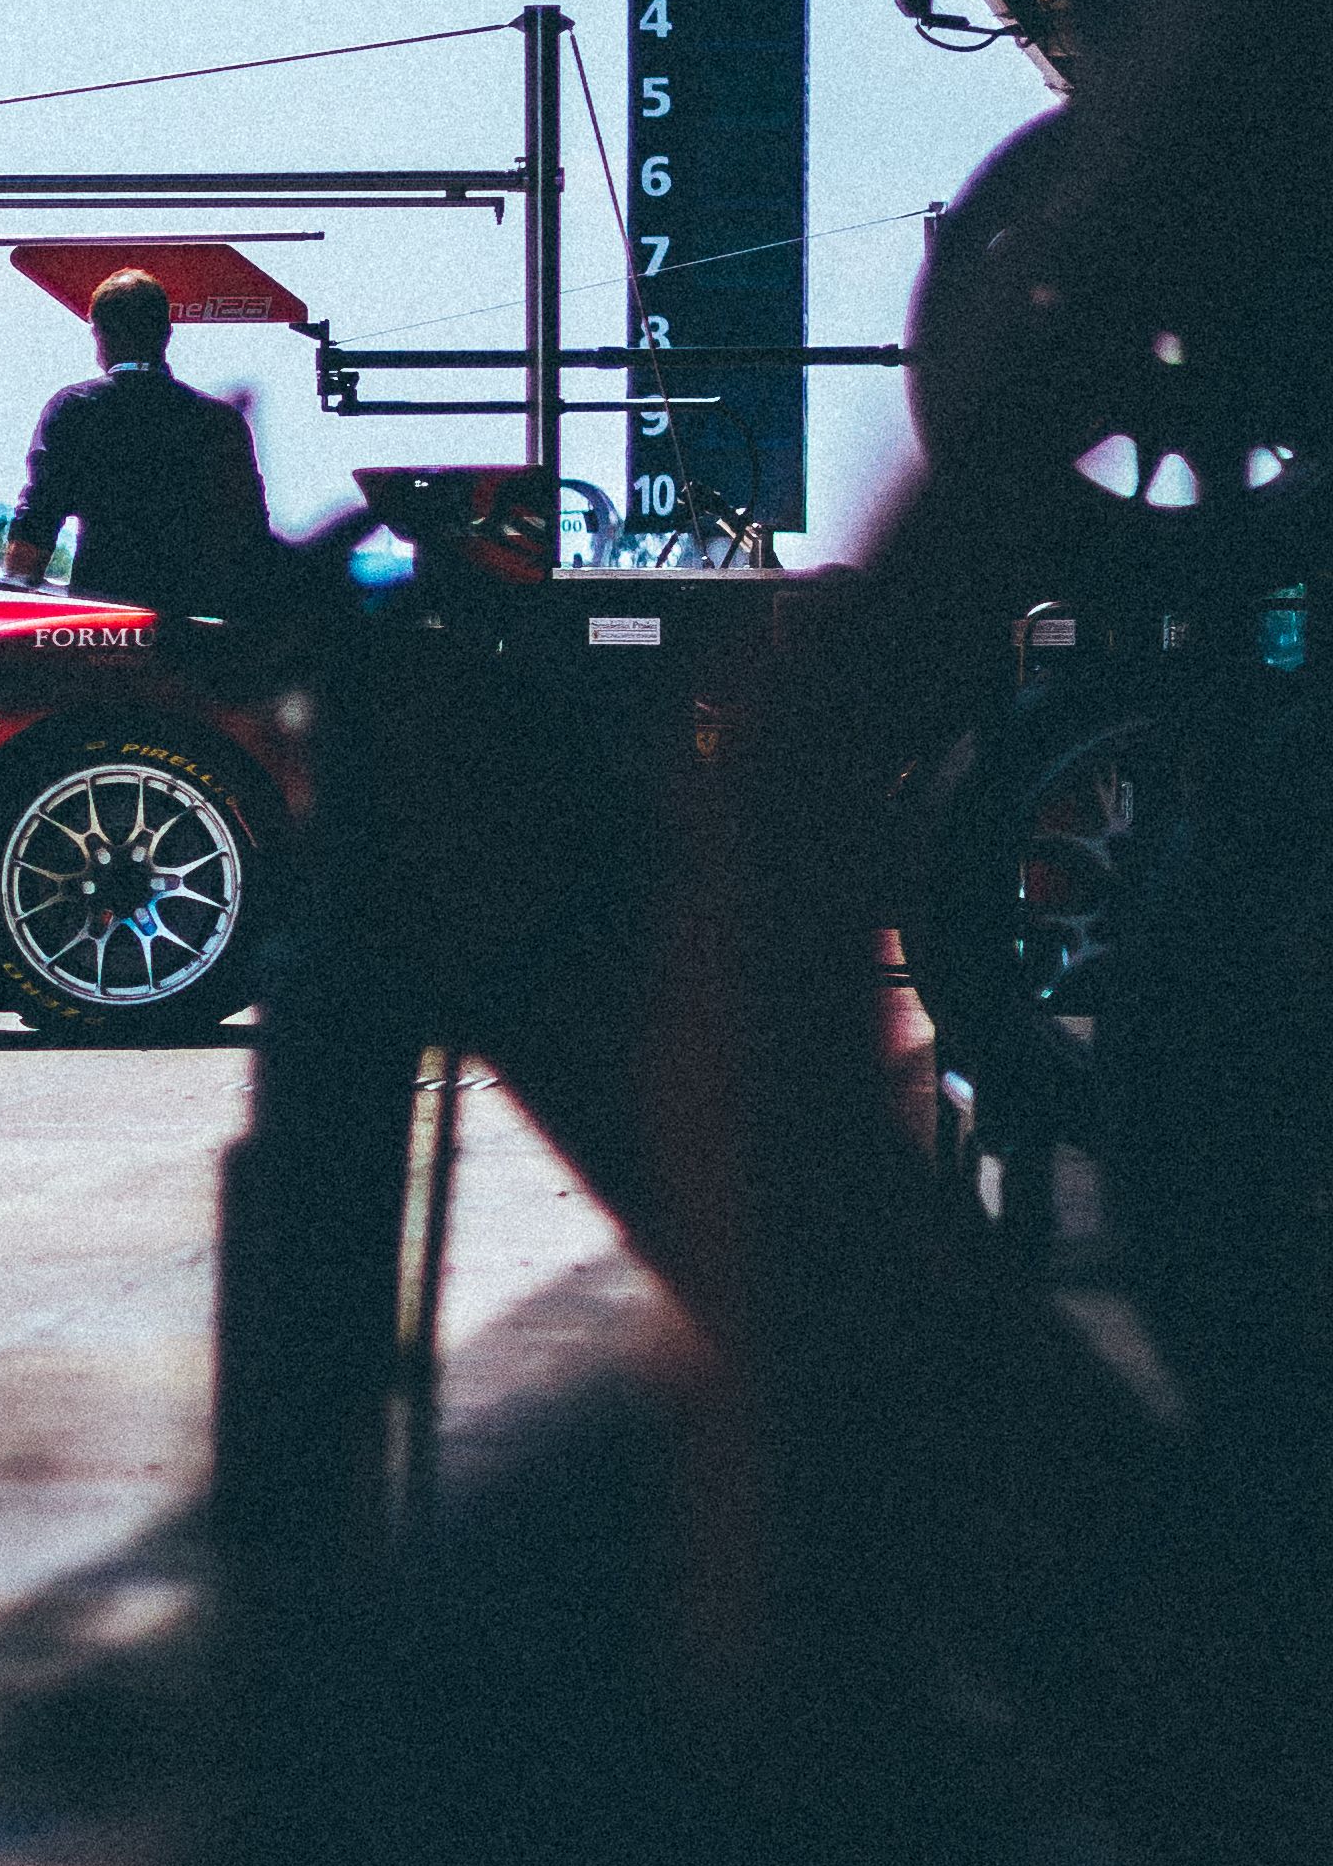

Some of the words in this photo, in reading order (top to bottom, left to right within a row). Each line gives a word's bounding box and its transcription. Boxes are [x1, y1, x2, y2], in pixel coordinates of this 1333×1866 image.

[641, 77, 673, 118] 5
[640, 155, 673, 198] 6
[640, 236, 671, 277] 7
[639, 315, 672, 350] 8
[633, 474, 676, 517] 10
[33, 627, 155, 648] FORMU
